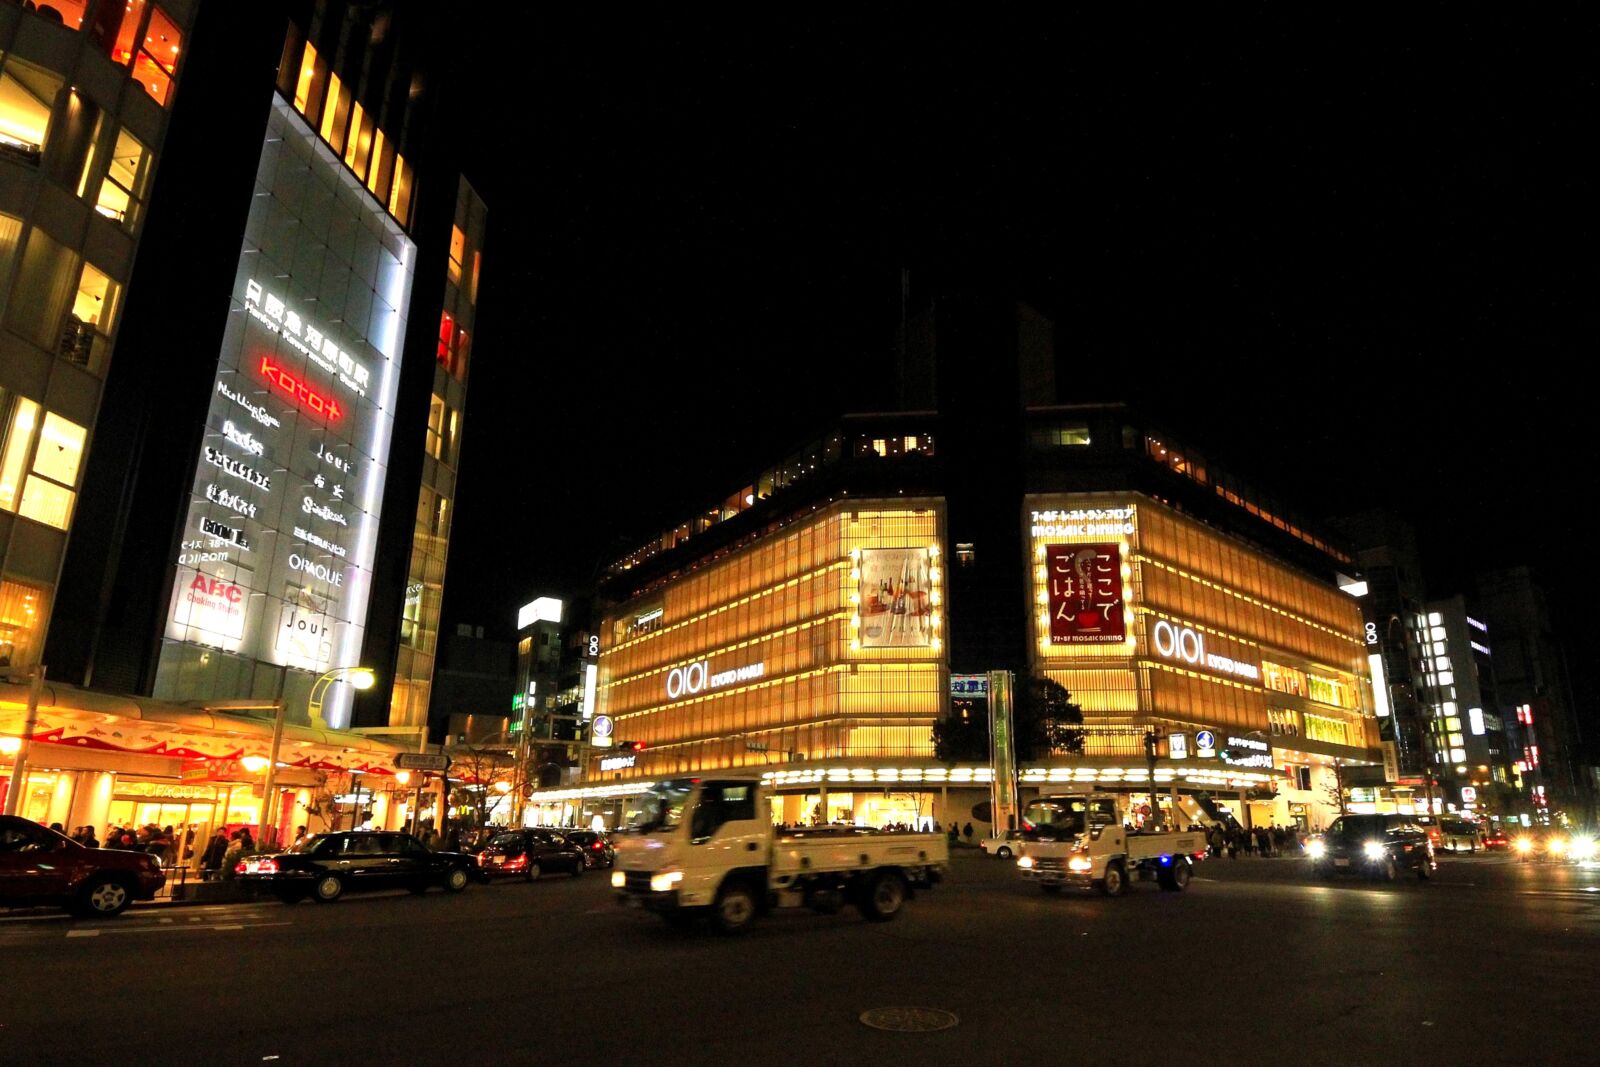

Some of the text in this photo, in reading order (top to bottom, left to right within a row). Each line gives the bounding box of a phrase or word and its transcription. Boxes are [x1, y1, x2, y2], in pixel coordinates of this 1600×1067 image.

[245, 301, 279, 332] Hankyu
[1031, 523, 1135, 537] MOSAIC DINING
[289, 554, 342, 587] OPAQUE
[187, 592, 216, 610] Cooking
[190, 572, 242, 603] ABC
[1053, 553, 1075, 622] ごはん
[1096, 554, 1119, 621] ここで
[287, 611, 328, 637] Jour
[711, 669, 737, 688] KYOTO
